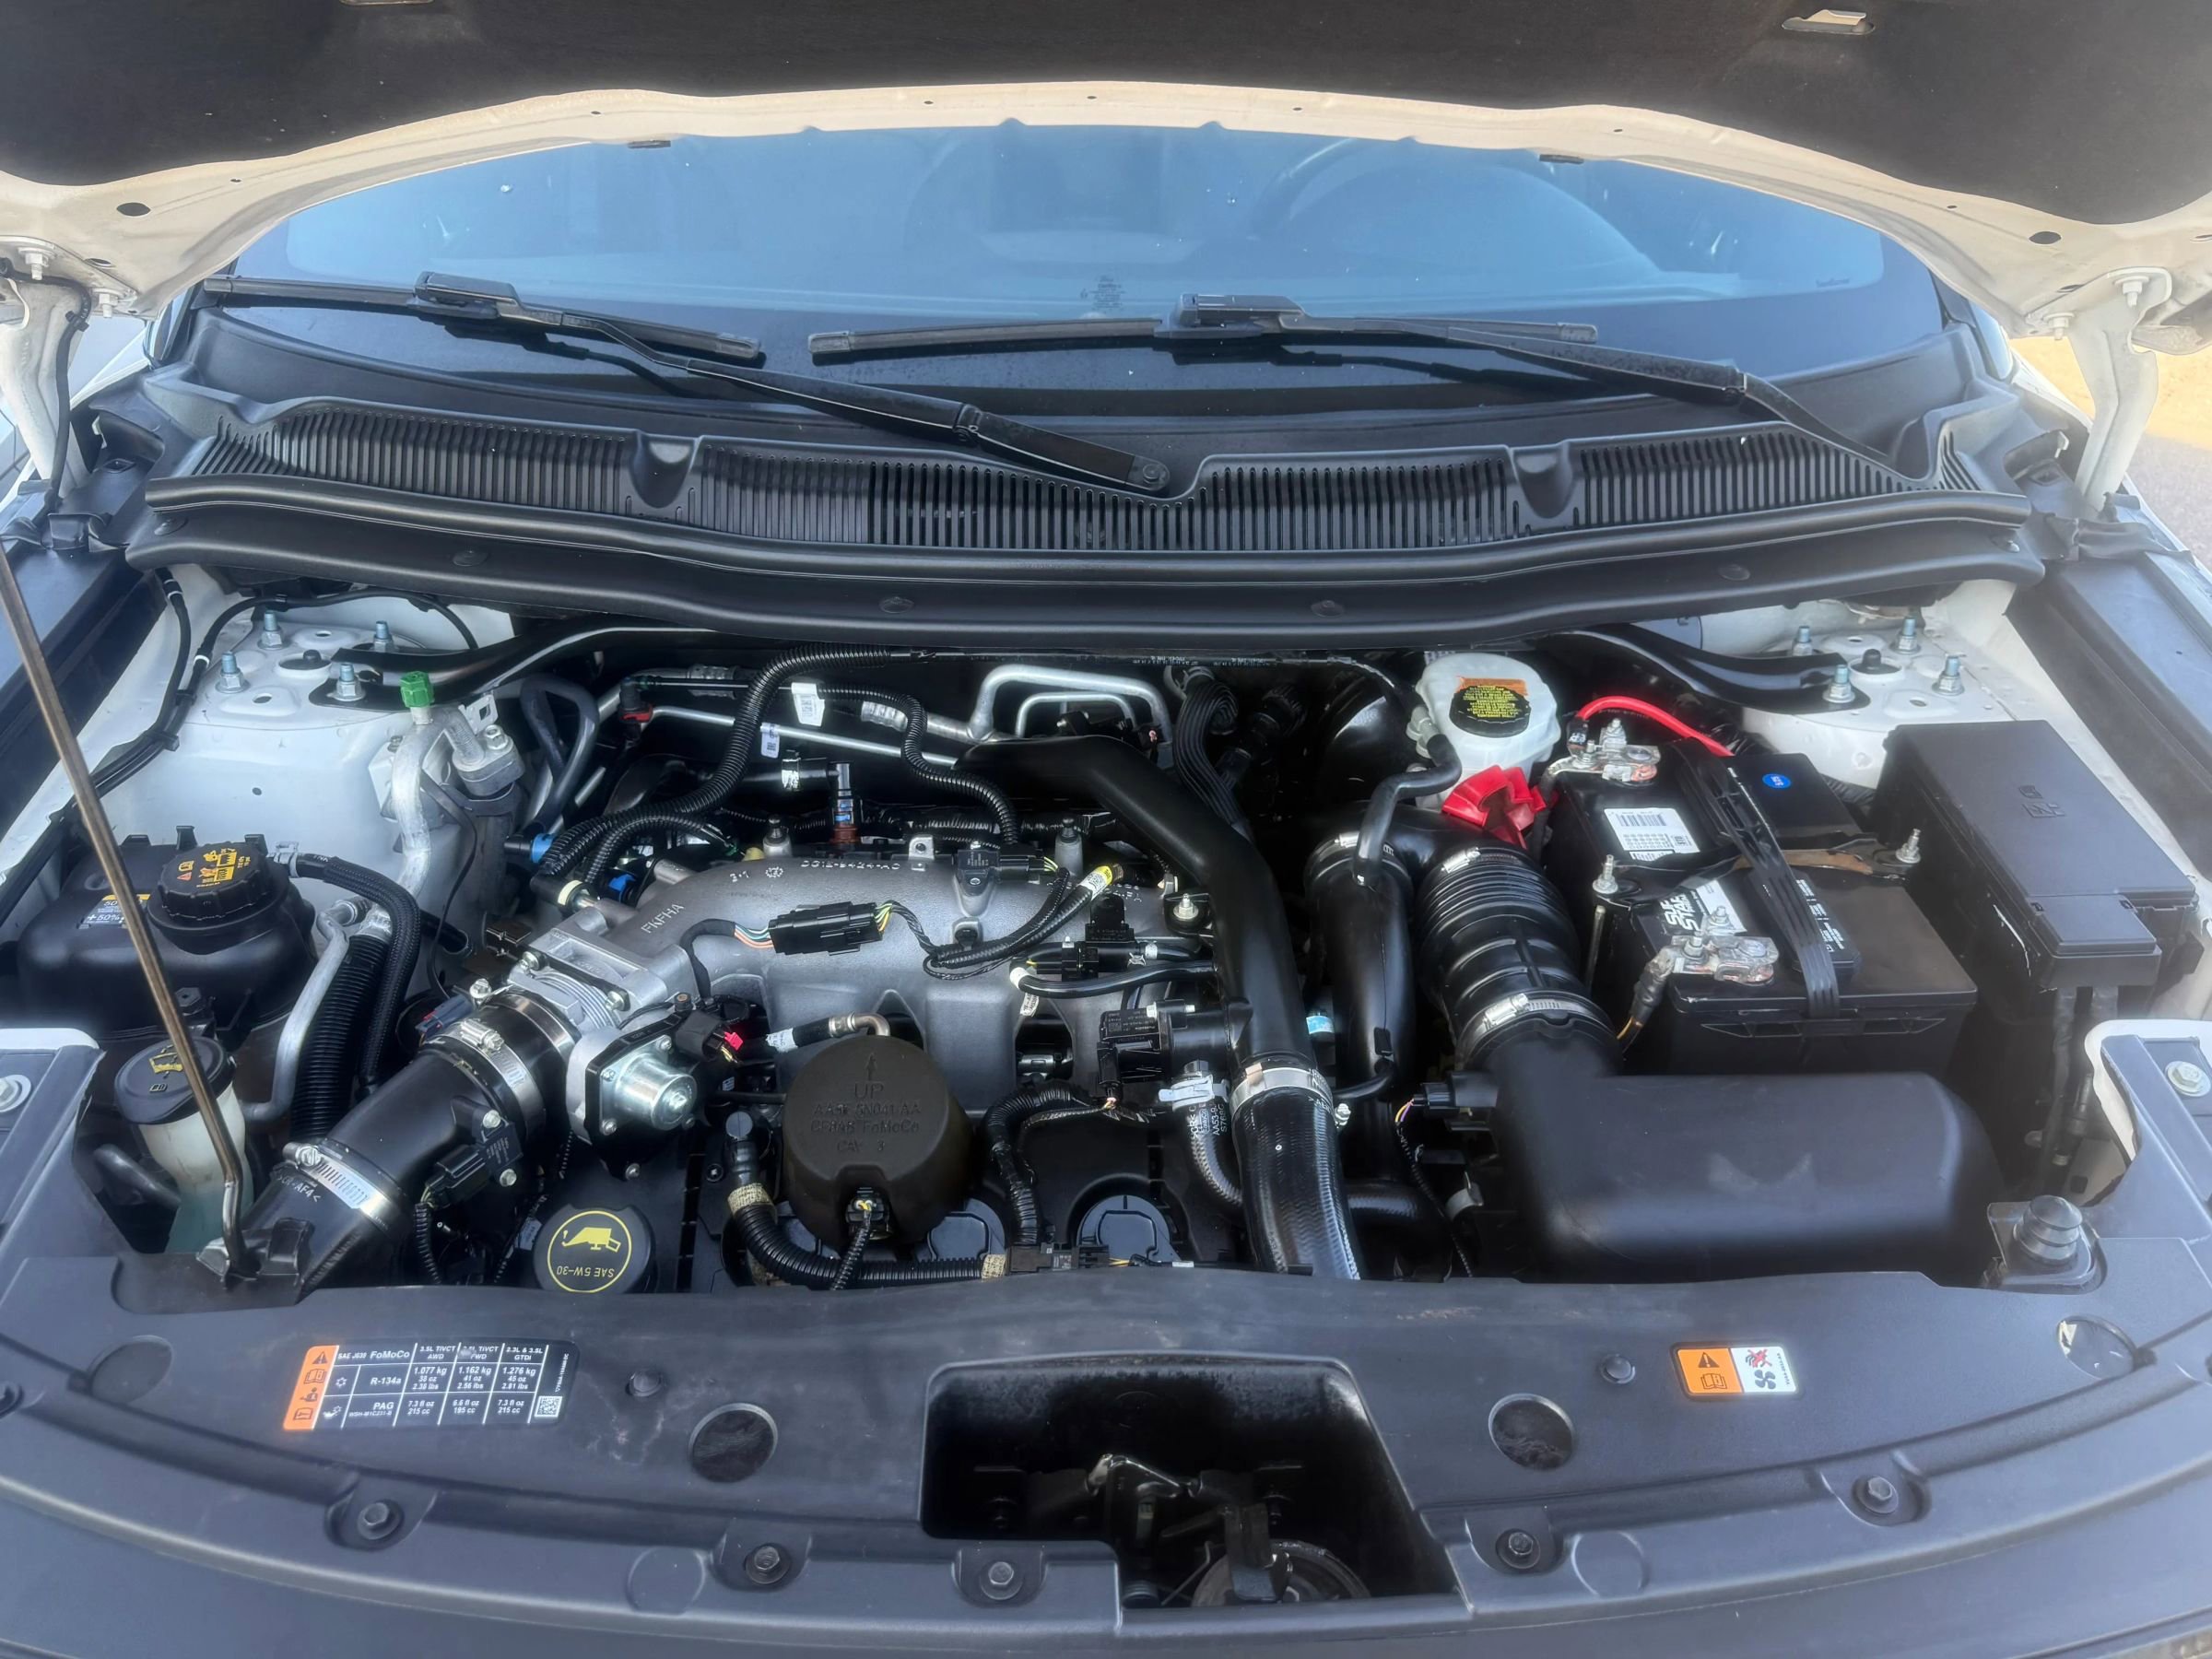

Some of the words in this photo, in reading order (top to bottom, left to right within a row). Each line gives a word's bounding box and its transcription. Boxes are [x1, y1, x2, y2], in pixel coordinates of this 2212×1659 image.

[854, 1083, 885, 1099] UP
[557, 1265, 591, 1277] 5W-30
[594, 1267, 615, 1277] SAE
[370, 1350, 410, 1359] FoMoCo
[436, 1367, 447, 1376] kg
[481, 1367, 492, 1375] kg
[525, 1367, 535, 1376] kg
[371, 1377, 402, 1385] R-134a
[373, 1402, 394, 1410] PAG
